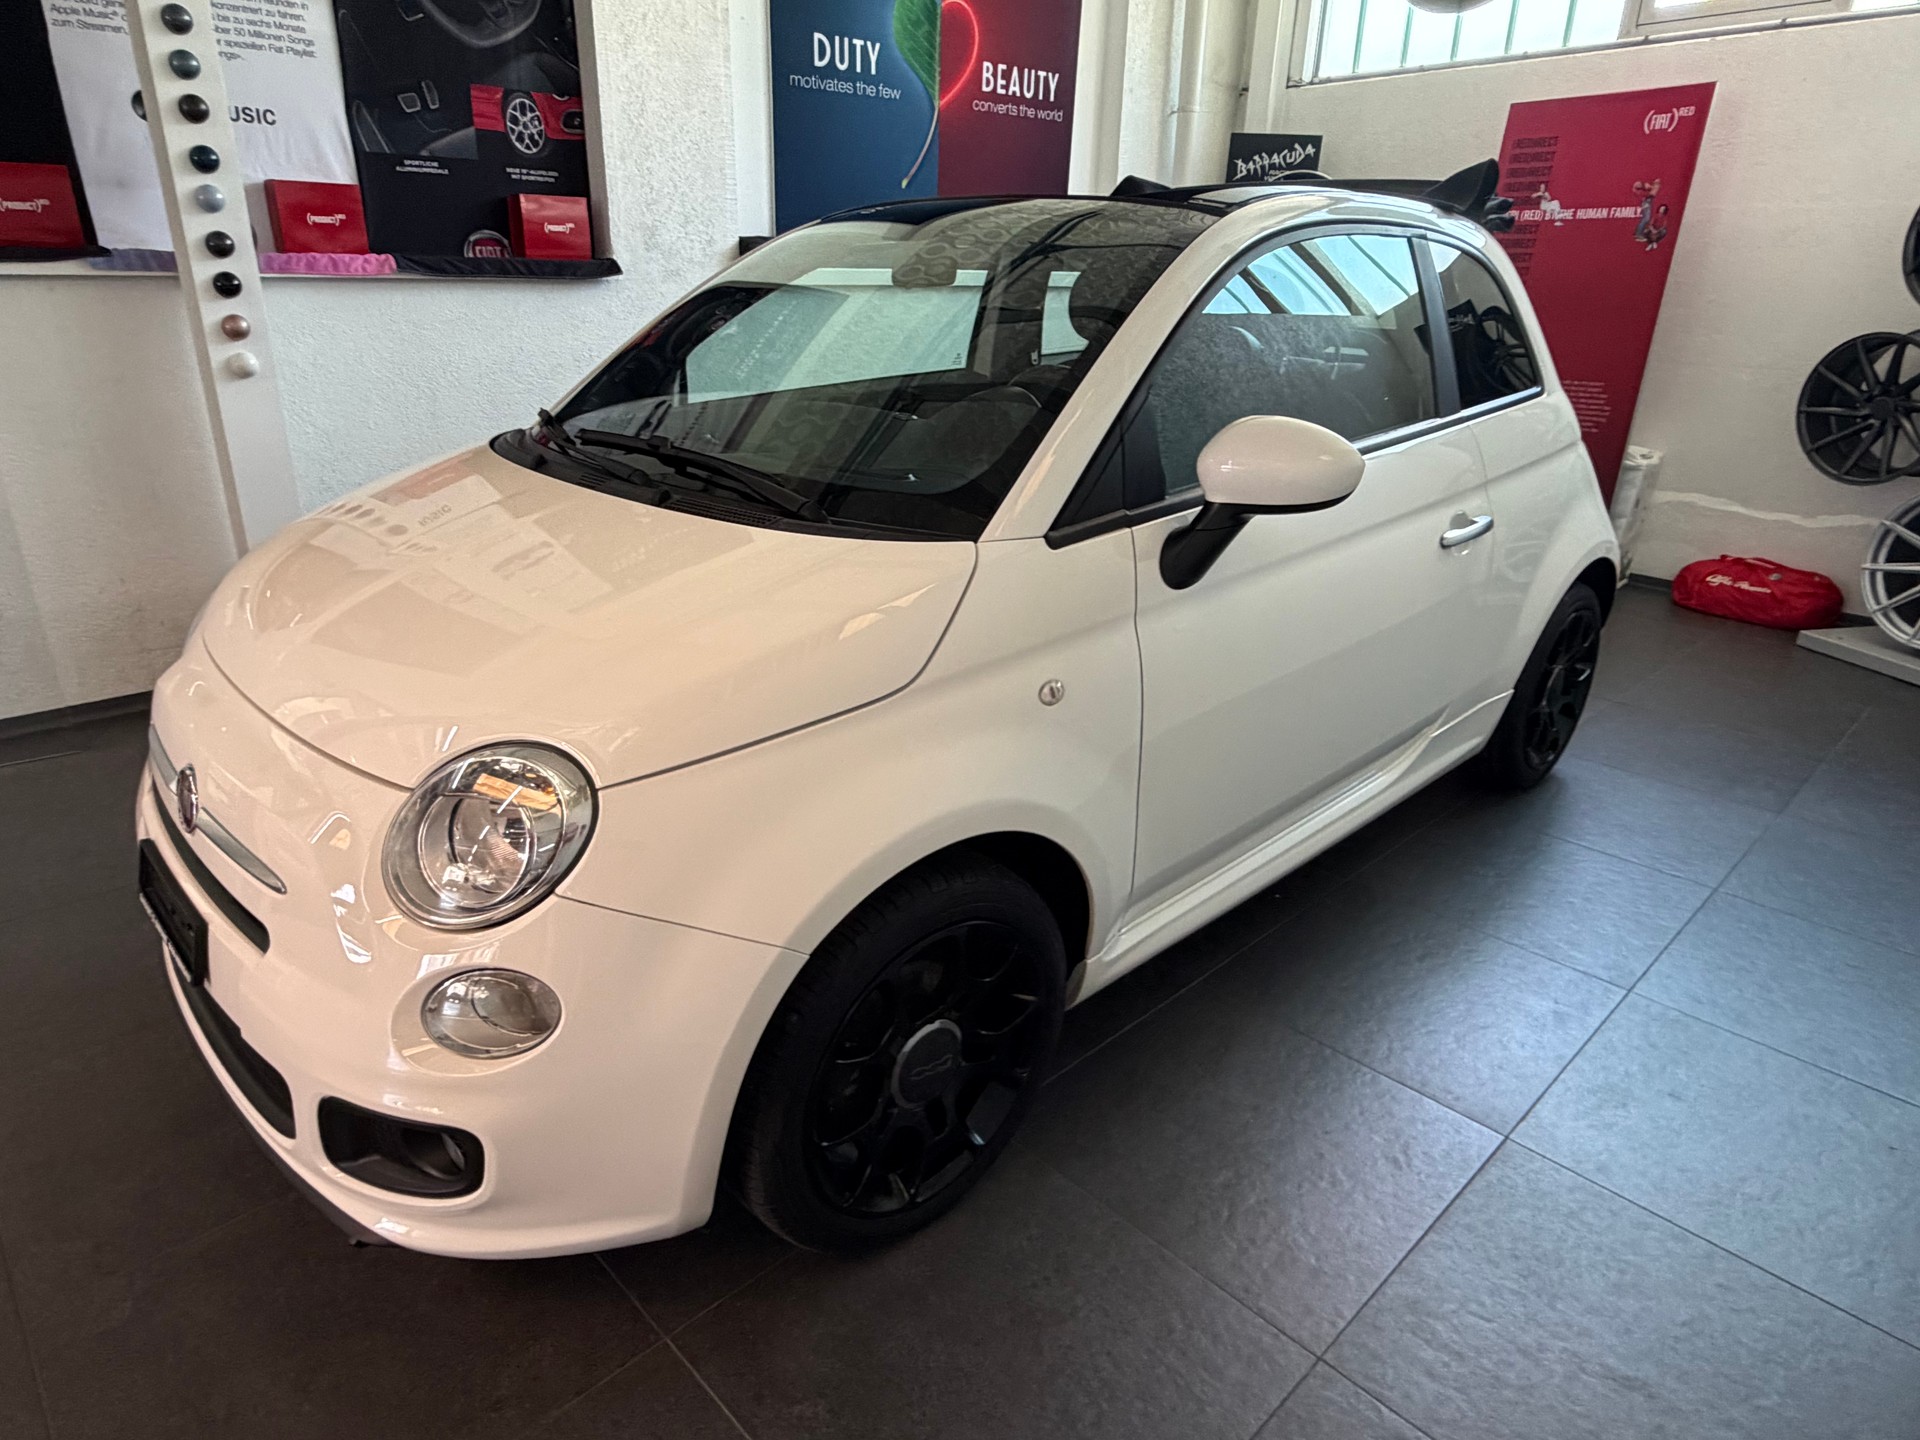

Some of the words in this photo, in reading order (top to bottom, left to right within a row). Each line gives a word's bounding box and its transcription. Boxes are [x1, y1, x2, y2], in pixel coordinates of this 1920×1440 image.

[233, 27, 246, 37] 50
[813, 31, 881, 75] DUTY
[789, 74, 854, 94] motivates
[856, 81, 877, 97] the
[878, 83, 902, 100] few
[981, 60, 1060, 102] BEAUTY
[230, 105, 277, 126] USIC
[972, 99, 1018, 116] converts
[1019, 104, 1036, 119] the
[1036, 108, 1064, 122] world
[1231, 142, 1317, 181] BARRACUDA
[1575, 207, 1608, 220] HUMAN
